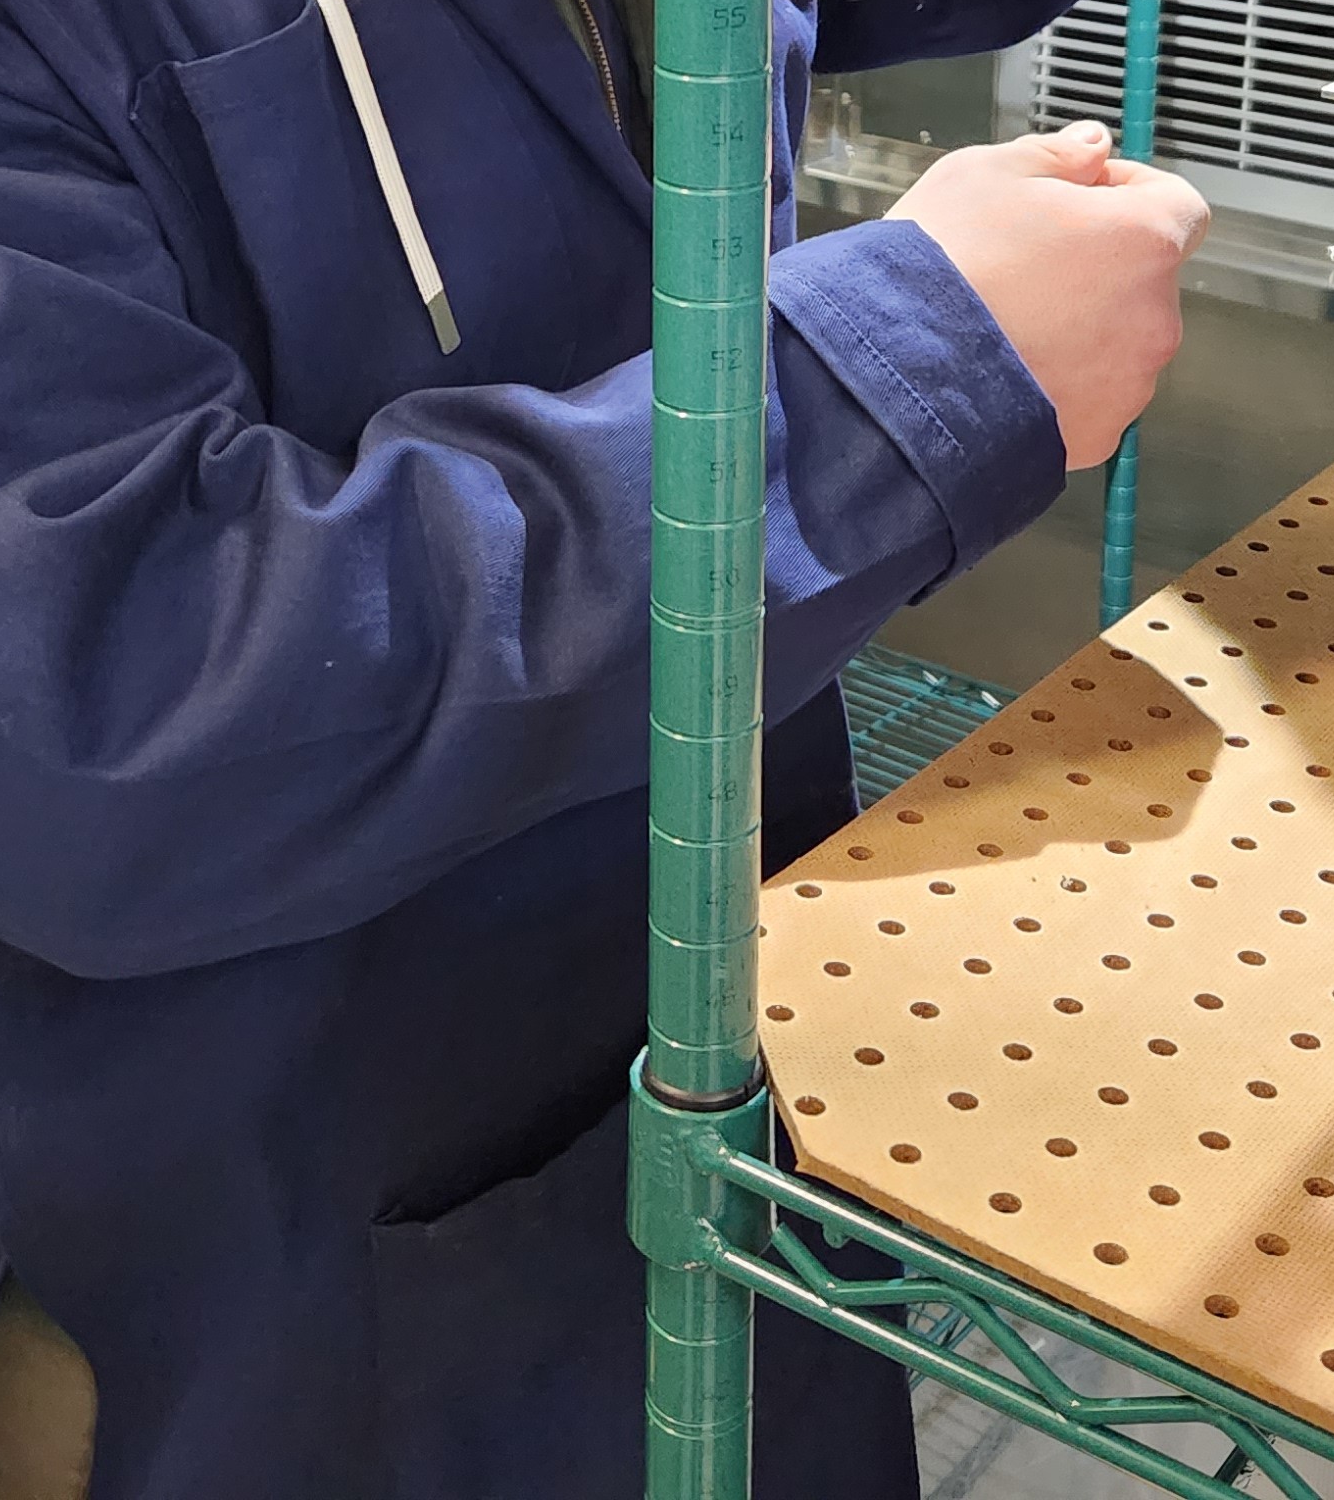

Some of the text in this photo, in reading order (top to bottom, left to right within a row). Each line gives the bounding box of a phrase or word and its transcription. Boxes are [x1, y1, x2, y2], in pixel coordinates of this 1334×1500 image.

[713, 5, 747, 31] 55
[712, 120, 744, 147] 54
[711, 236, 743, 260] 53
[710, 347, 743, 372] 52
[710, 459, 738, 483] 51
